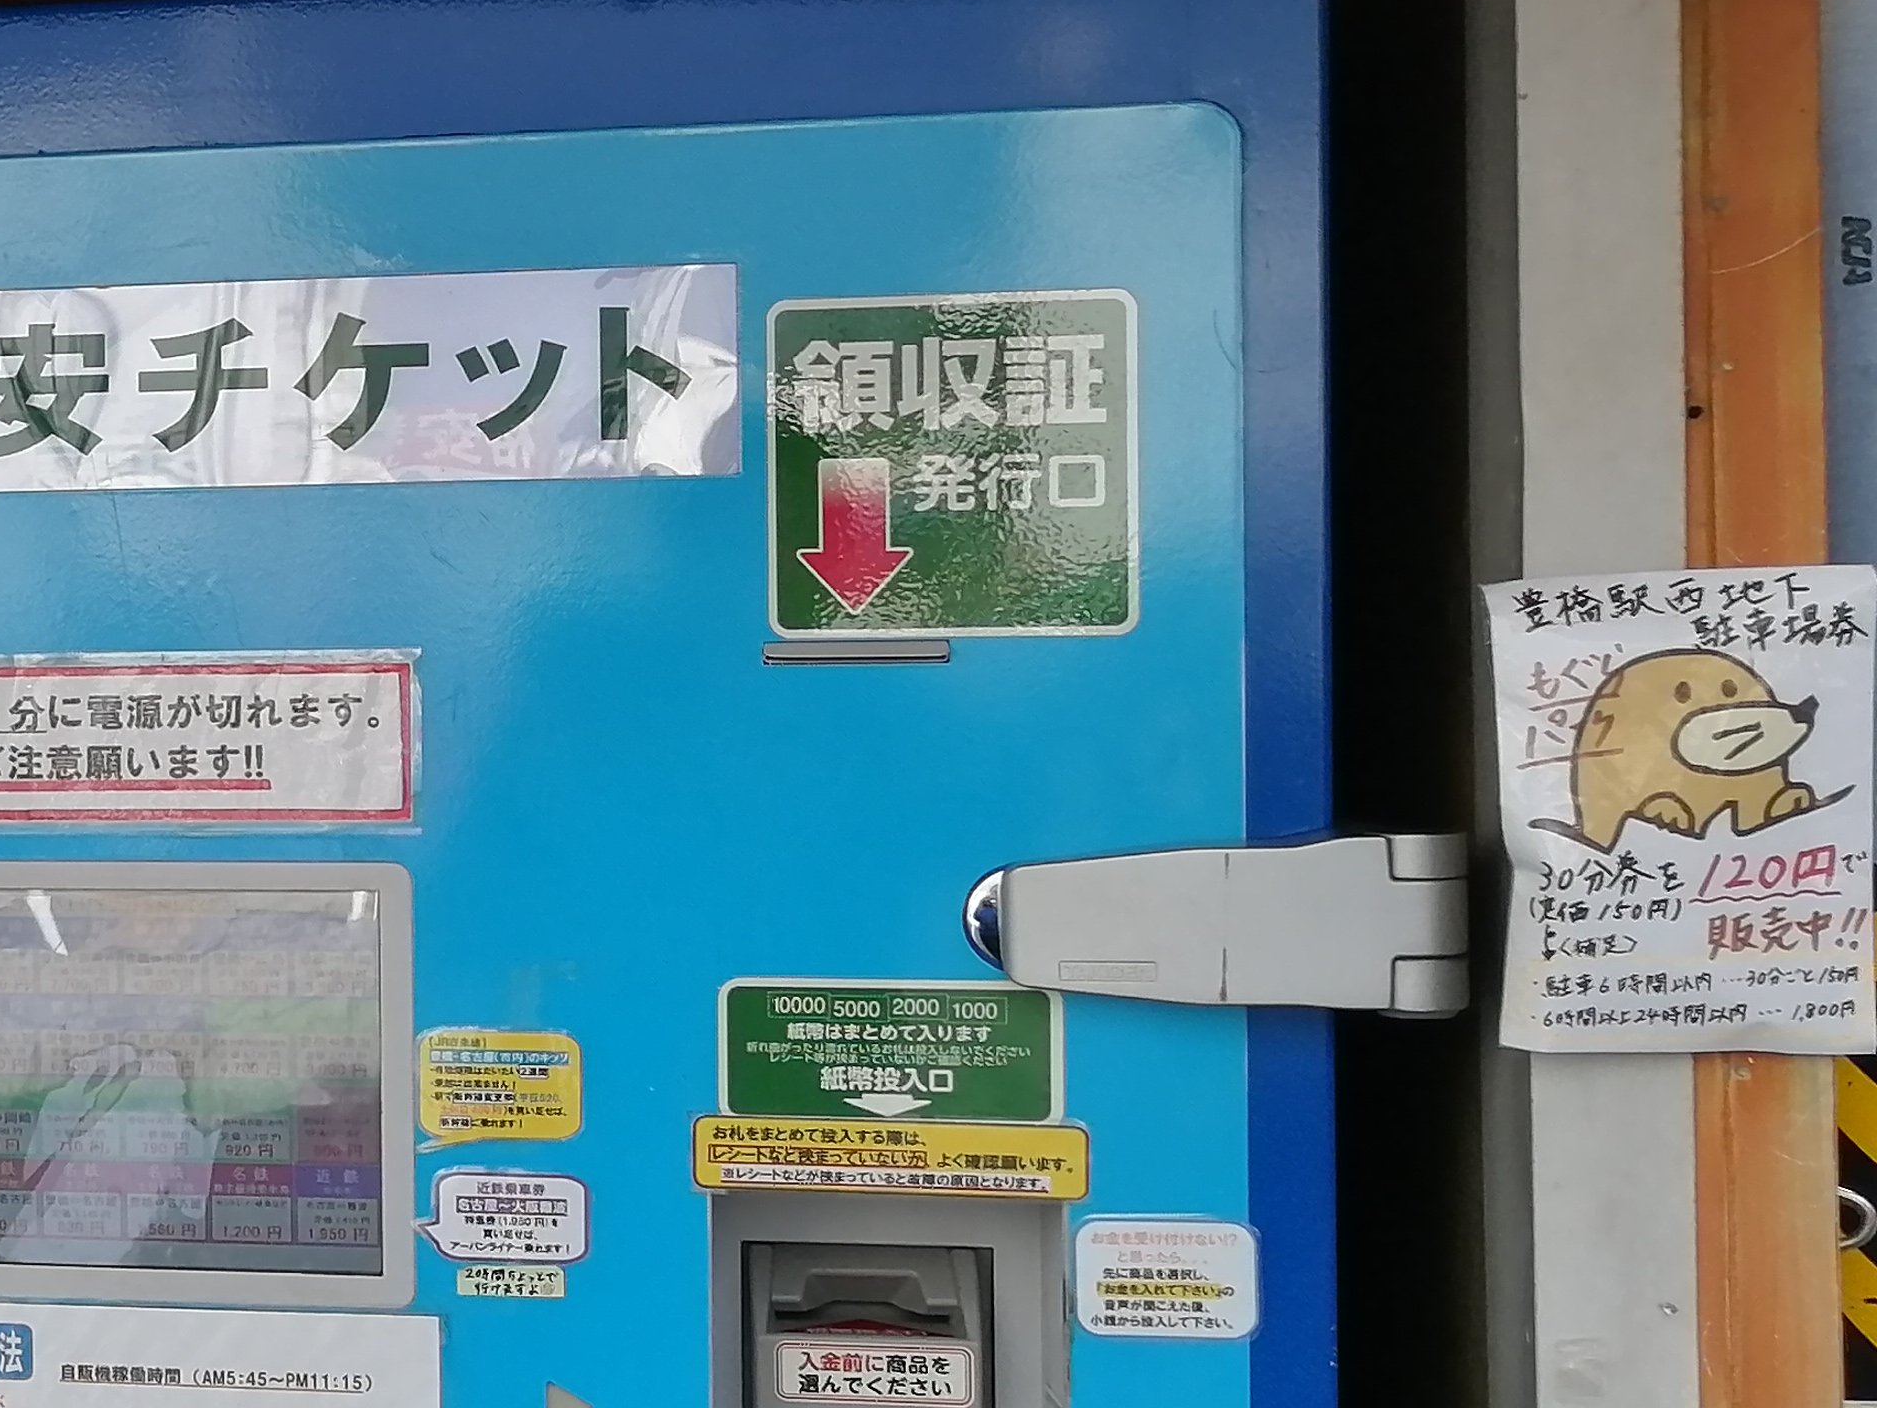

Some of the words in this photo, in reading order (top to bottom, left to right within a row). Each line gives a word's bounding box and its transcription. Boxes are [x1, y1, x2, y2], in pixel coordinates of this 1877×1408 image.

[793, 330, 1108, 431] 領収証
[909, 455, 1108, 513] 発行口
[1514, 573, 1810, 629] 豊橋駅西地下
[1690, 601, 1869, 651] 駐車場券
[773, 998, 826, 1014] 10000
[833, 1000, 881, 1018] 5000
[893, 999, 940, 1016] 2000
[952, 1002, 997, 1020] 1000
[787, 1024, 992, 1042] 紙幣はまとめて入ります
[820, 1068, 954, 1092] 紙幣投入口
[712, 1124, 927, 1147] お札をまとめて投入する際は、
[798, 1351, 951, 1376] 入金前に商品を
[798, 1373, 952, 1398] 選んでください
